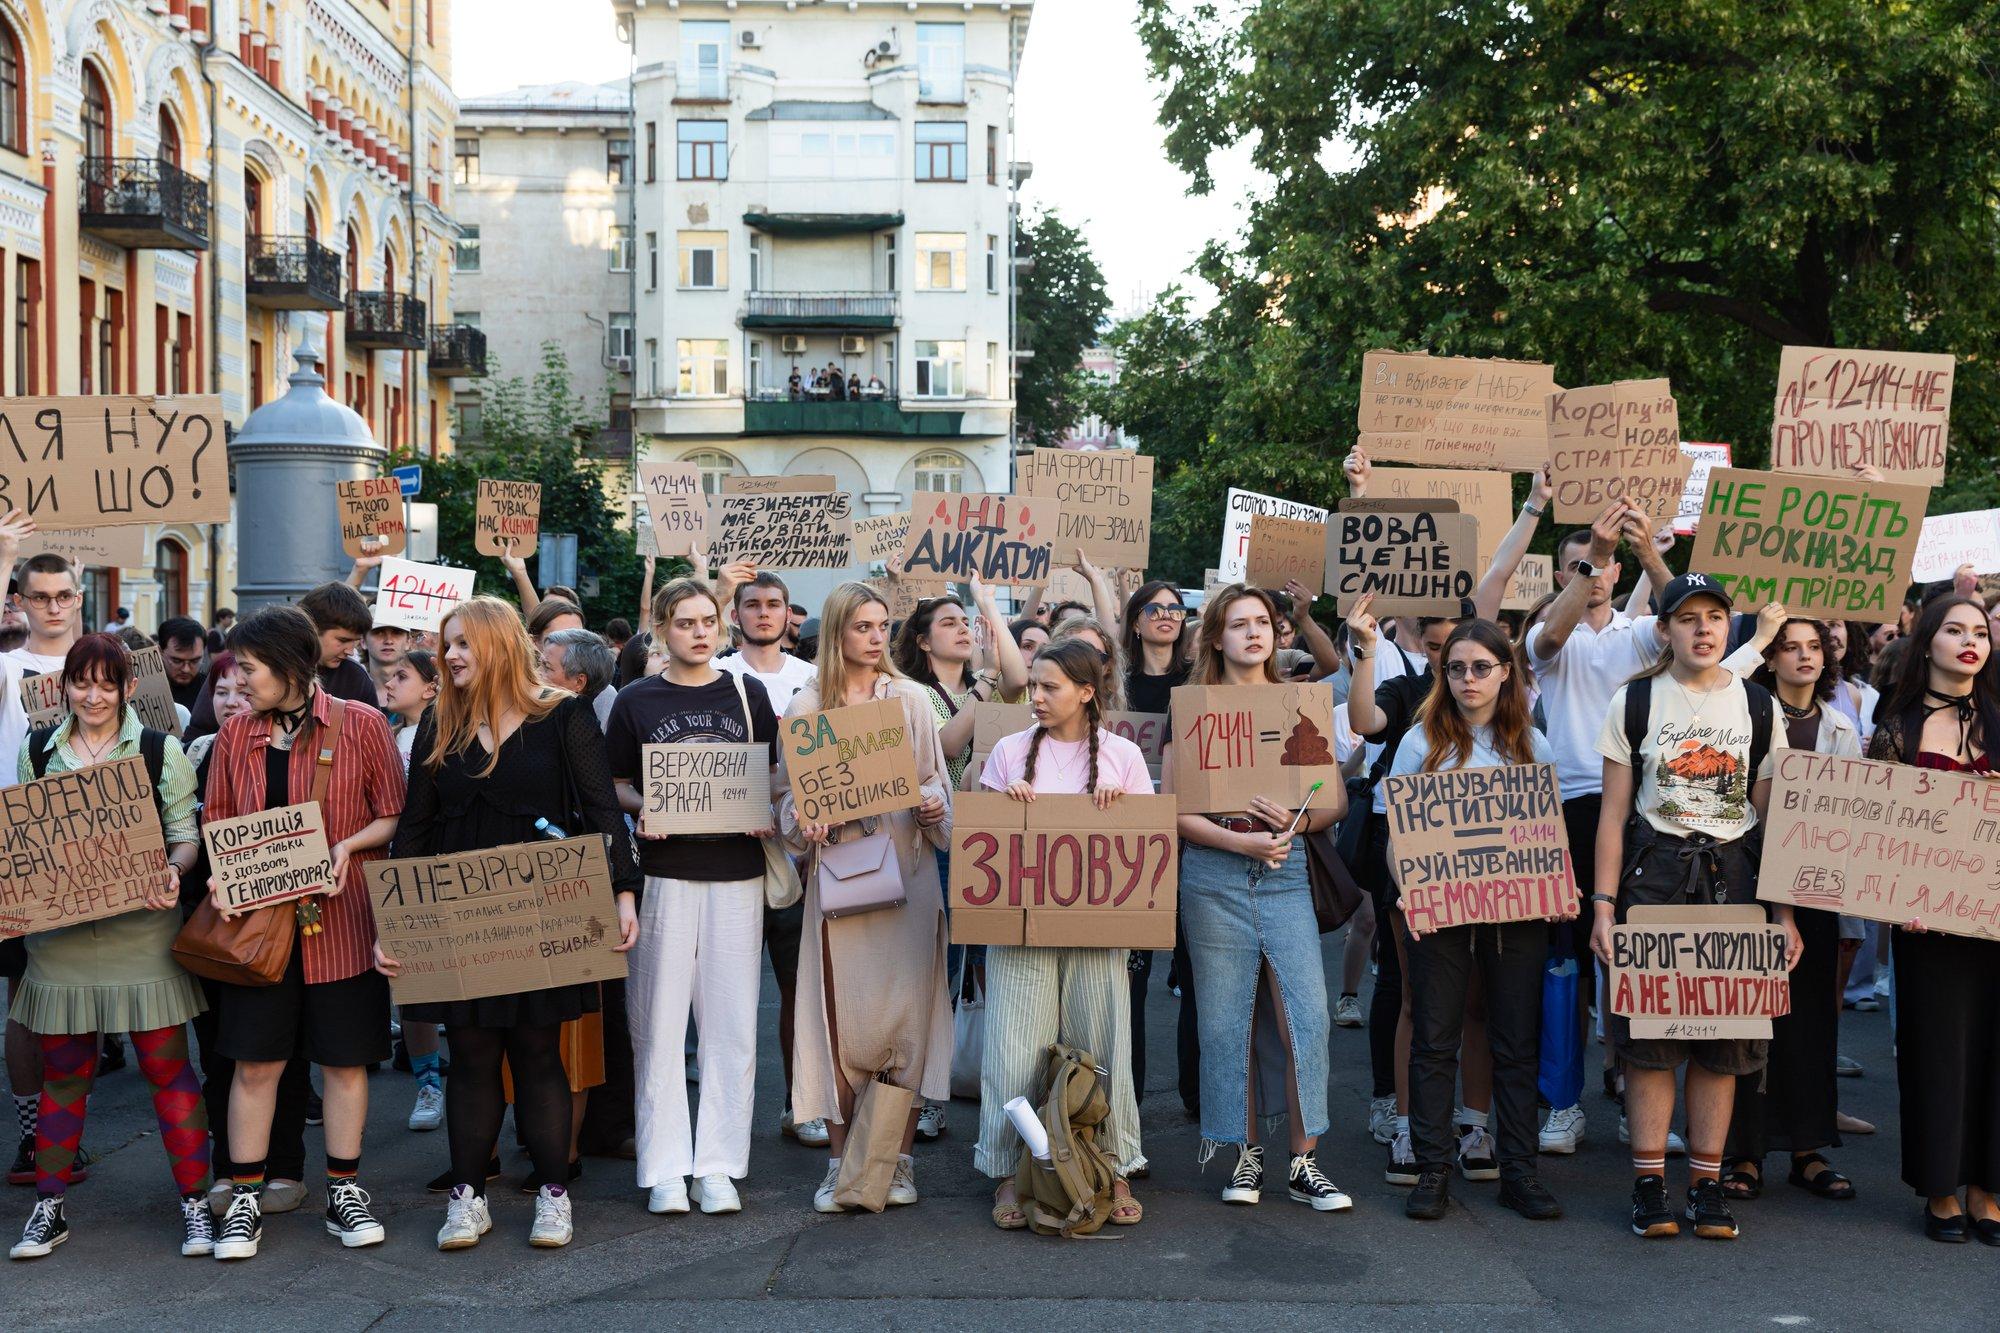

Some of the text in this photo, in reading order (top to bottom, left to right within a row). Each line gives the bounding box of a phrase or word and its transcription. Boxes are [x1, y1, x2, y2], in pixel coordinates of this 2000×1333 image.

[1476, 372, 1536, 401] НАБУ
[1625, 427, 1678, 446] НОВА
[1776, 420, 1824, 467] ПРО
[1555, 447, 1677, 471] СТРАТЕГІЯ
[339, 478, 400, 499] ЦЕ БІДА
[651, 475, 696, 495] 12414
[1057, 482, 1130, 506] СМЕРТЬ
[1558, 475, 1681, 506] ОБОРОНИ
[347, 498, 389, 514] ТАКОГО
[721, 509, 825, 526] МАЄ ПРАВА
[723, 495, 827, 512] ПРЕЗИДЕНТ
[1709, 481, 1766, 518] НЕ
[1778, 487, 1909, 538] РОБІТЬ
[343, 520, 405, 540] НІДЕ НЕМА
[478, 514, 499, 534] НАС
[661, 511, 702, 531] 1984
[722, 521, 829, 541] КЕРУВАТИ
[854, 517, 892, 533] ВЛАДІ
[877, 526, 910, 542] СЛУХ
[871, 540, 906, 555] НАРО
[1339, 547, 1396, 573] ЦЕ
[1403, 545, 1450, 571] НЕ
[1339, 570, 1473, 598] СМІШНО
[1515, 560, 1543, 578] ИТИ
[1782, 577, 1885, 612] ПРІРВА
[131, 650, 163, 678] ВІТЛО
[685, 714, 712, 727] YOUR
[720, 717, 743, 738] MIND
[791, 714, 904, 761] ЗА ВЛАДУ
[1185, 711, 1254, 770] 12414
[1657, 722, 1752, 749] Explore More
[649, 751, 748, 779] ВЕРХОВНА
[799, 762, 855, 795] БЕЗ
[649, 781, 747, 813] ЗРАДА 12414
[1386, 764, 1554, 805] РУЙНУВАННЯ
[1780, 753, 1894, 791] СТАТТЯ
[1953, 780, 2000, 813] ДЕ
[803, 777, 910, 820] ОФІСНИКІВ
[1395, 791, 1559, 834] ІНСТИТУЦІЙ
[1783, 788, 1949, 834] ВІДПОВІДАЄ
[0, 804, 143, 854] ИКТАТУРОЮ
[209, 811, 304, 853] КОРУПЦІЯ
[1510, 823, 1556, 844] 12414
[0, 832, 130, 880] ОВНІ, ПОКИ
[1781, 821, 1985, 874] ЛЮДИНОЮ
[380, 845, 586, 907] Я НЕ ВІРЮ ВРУ
[962, 831, 1171, 909] ЗНОВУ?
[1400, 847, 1565, 885] РУЙНУВАННЯ
[226, 859, 332, 905] ГЕНПРОКУРОРА?
[1792, 865, 1846, 898] БЕЗ
[1856, 873, 2000, 928] ДІЯЛЬН
[454, 904, 504, 922] ТОТАЛЬНЕ
[545, 879, 591, 906] НАМ
[391, 940, 434, 960] БУТИ
[438, 925, 534, 948] ГРОМАДЯНИНОМ
[473, 945, 535, 966] КОРУПЦІЯ
[1612, 930, 1787, 976] ВОРОГ-КОРУПЦІЯ
[1615, 972, 1792, 1018] А НЕ ІНСТИТУЦІЯ
[1665, 1024, 1718, 1038] #12414
